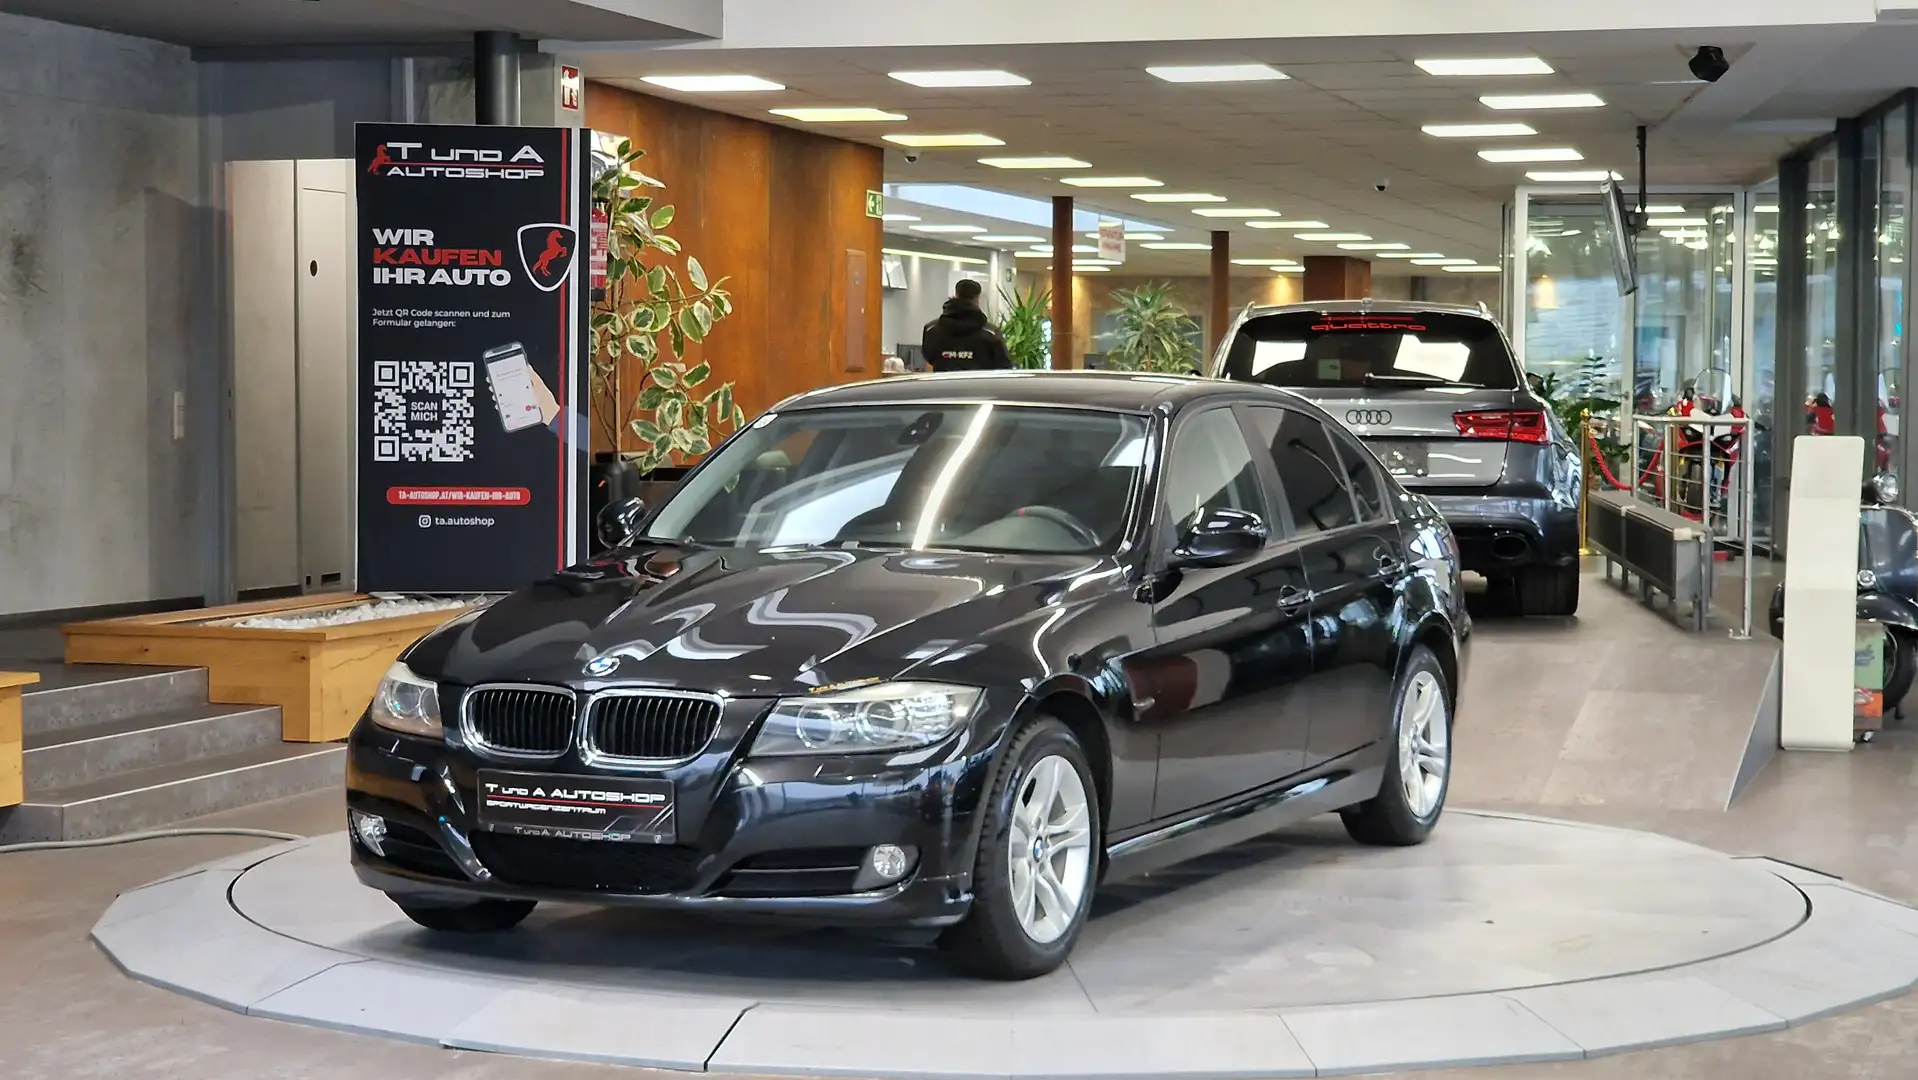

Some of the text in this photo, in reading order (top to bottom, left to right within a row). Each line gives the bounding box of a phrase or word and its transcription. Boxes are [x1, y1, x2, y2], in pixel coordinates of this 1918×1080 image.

[386, 142, 423, 160] T
[509, 145, 545, 163] A
[386, 166, 545, 180] AUTOSHOP
[372, 228, 434, 246] WIR
[373, 247, 503, 267] KAUFEN
[373, 267, 512, 287] IHR AUTO
[372, 308, 394, 317] Jetzt
[395, 309, 409, 318] QR
[410, 308, 433, 317] Code
[434, 310, 471, 318] scannen
[472, 310, 490, 318] und
[372, 318, 457, 329] Formular gelangen:
[1311, 322, 1426, 331] quattro
[410, 401, 438, 411] SCAN
[410, 411, 438, 422] MICH
[435, 516, 495, 528] ta.autoshop
[485, 783, 499, 793] T
[532, 787, 546, 797] A
[551, 788, 666, 804] AUTOSHOP
[514, 826, 523, 834] T
[541, 828, 550, 836] A
[555, 830, 631, 842] AUTOSHOP
